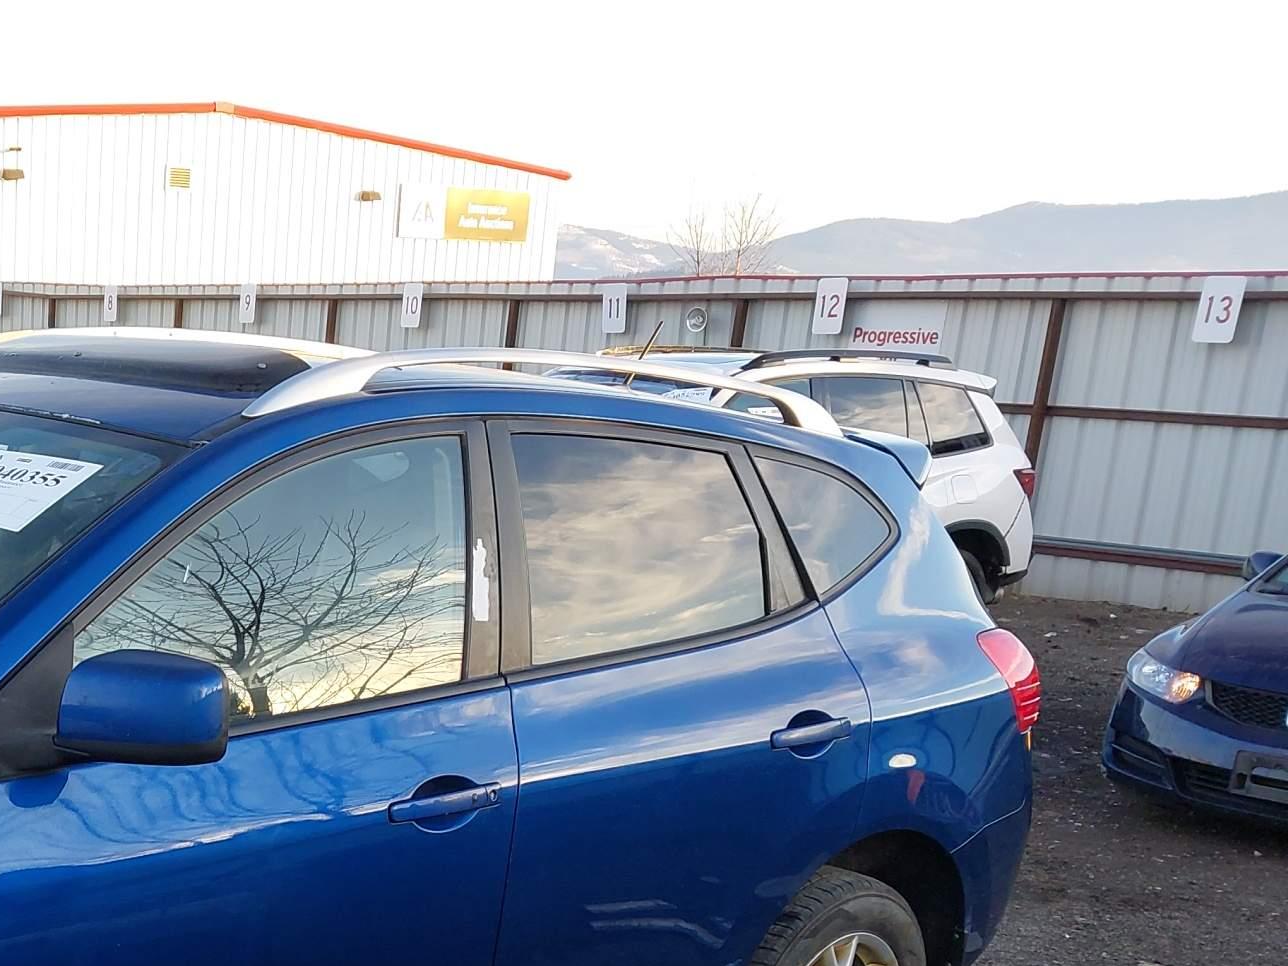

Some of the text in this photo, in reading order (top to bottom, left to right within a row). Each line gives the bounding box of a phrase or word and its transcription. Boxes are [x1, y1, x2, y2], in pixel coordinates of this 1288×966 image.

[107, 295, 113, 311] 8
[244, 294, 251, 311] 9
[405, 295, 418, 315] 10
[608, 297, 620, 319] 11
[820, 294, 840, 318] 12
[1204, 295, 1233, 324] 13
[853, 326, 939, 347] Progressive
